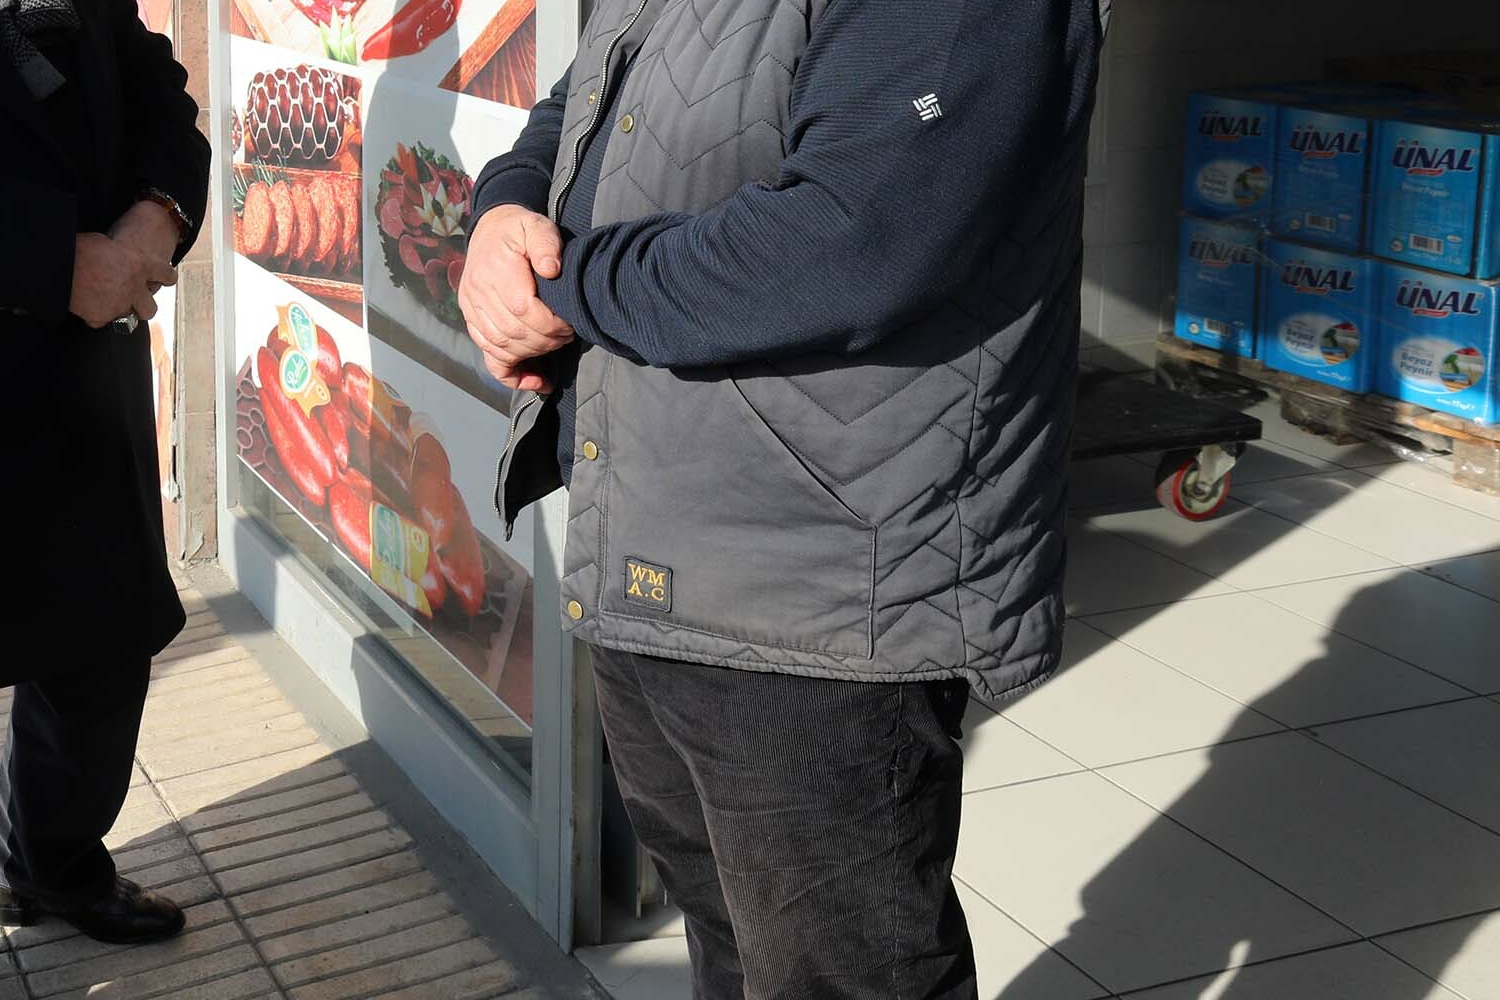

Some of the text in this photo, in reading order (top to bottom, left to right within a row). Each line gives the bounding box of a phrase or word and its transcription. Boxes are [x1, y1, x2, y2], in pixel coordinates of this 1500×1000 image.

[1197, 108, 1264, 137] ÜNAL
[1288, 124, 1361, 154] ÜNAL
[1392, 139, 1476, 173] ÜNAL
[1280, 259, 1356, 292] ÜNAL
[1396, 279, 1482, 316] ÜNAL
[628, 563, 665, 586] WM
[628, 581, 664, 601] A.C
